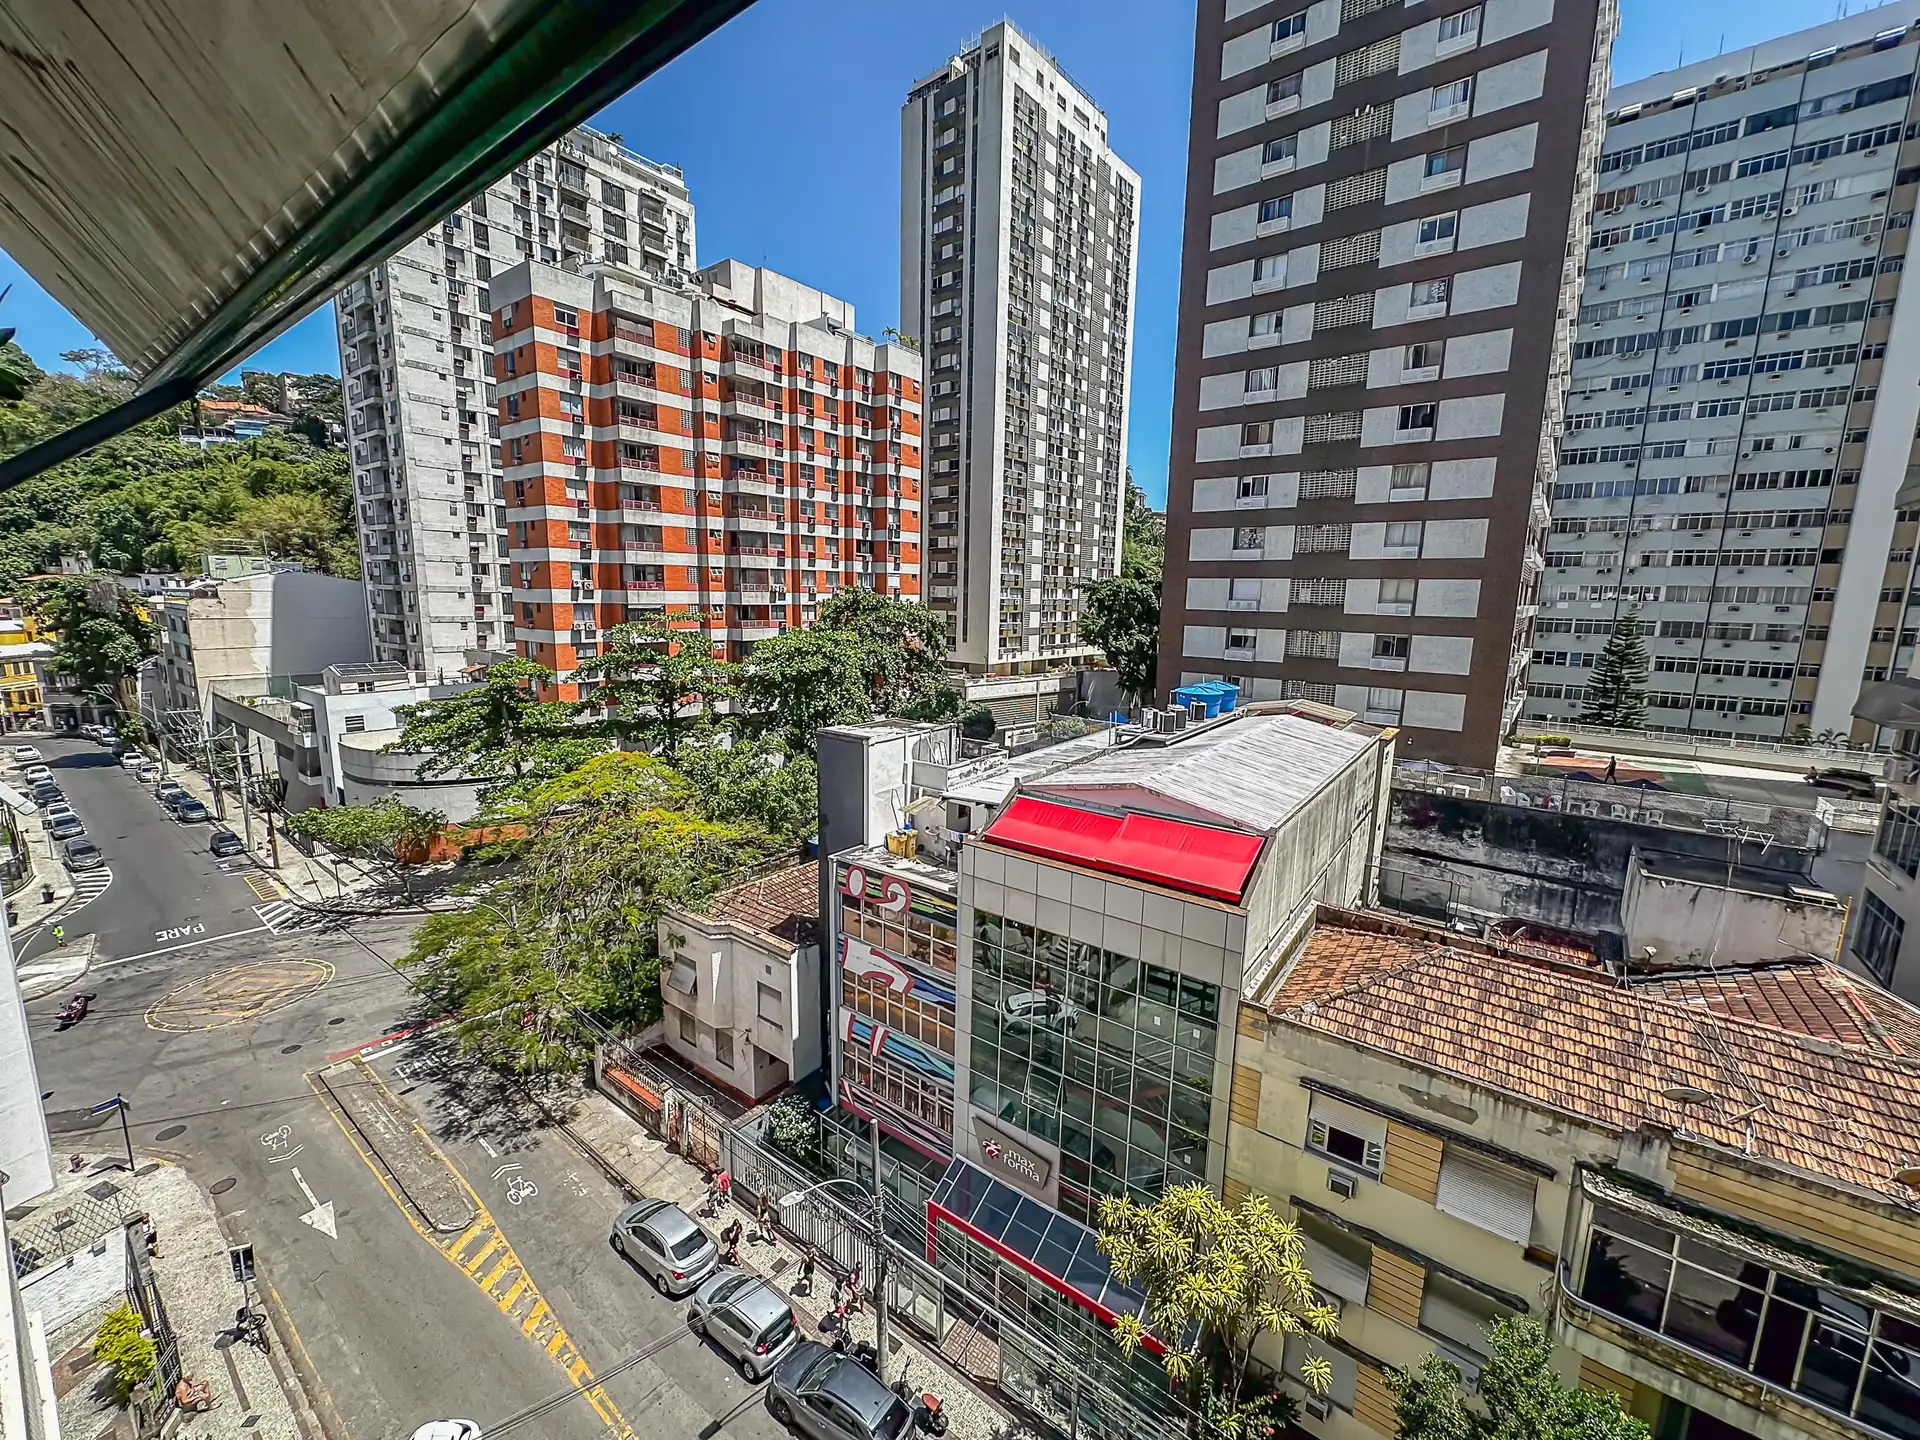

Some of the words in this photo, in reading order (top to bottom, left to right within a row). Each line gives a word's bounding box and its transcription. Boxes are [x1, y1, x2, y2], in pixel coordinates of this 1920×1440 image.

[155, 922, 206, 942] PARE
[1003, 1153, 1040, 1182] forma
[1008, 1149, 1036, 1171] max
